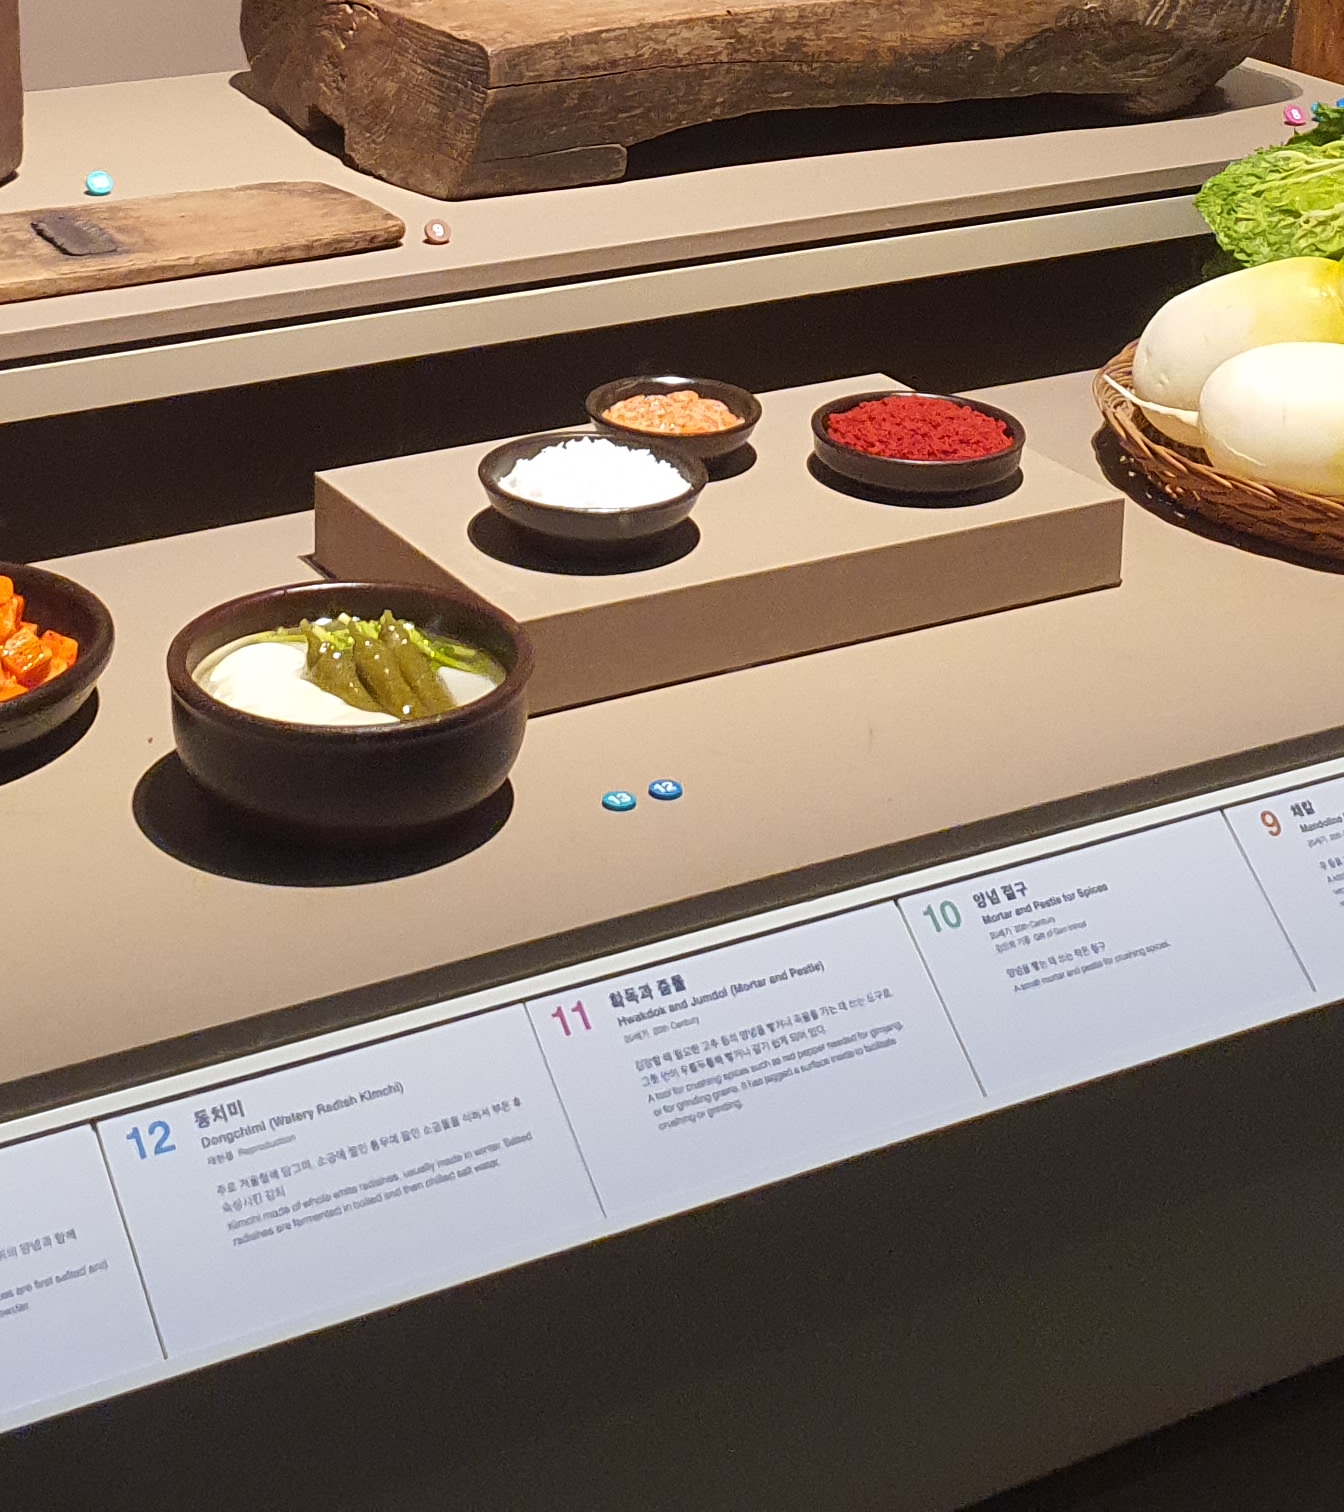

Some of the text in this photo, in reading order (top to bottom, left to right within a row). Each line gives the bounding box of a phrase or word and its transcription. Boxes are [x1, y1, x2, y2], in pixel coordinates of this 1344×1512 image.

[1259, 810, 1281, 836] 9
[921, 899, 962, 932] 10
[550, 999, 591, 1036] 11
[193, 1099, 245, 1128] 동치미
[125, 1119, 176, 1159] 12
